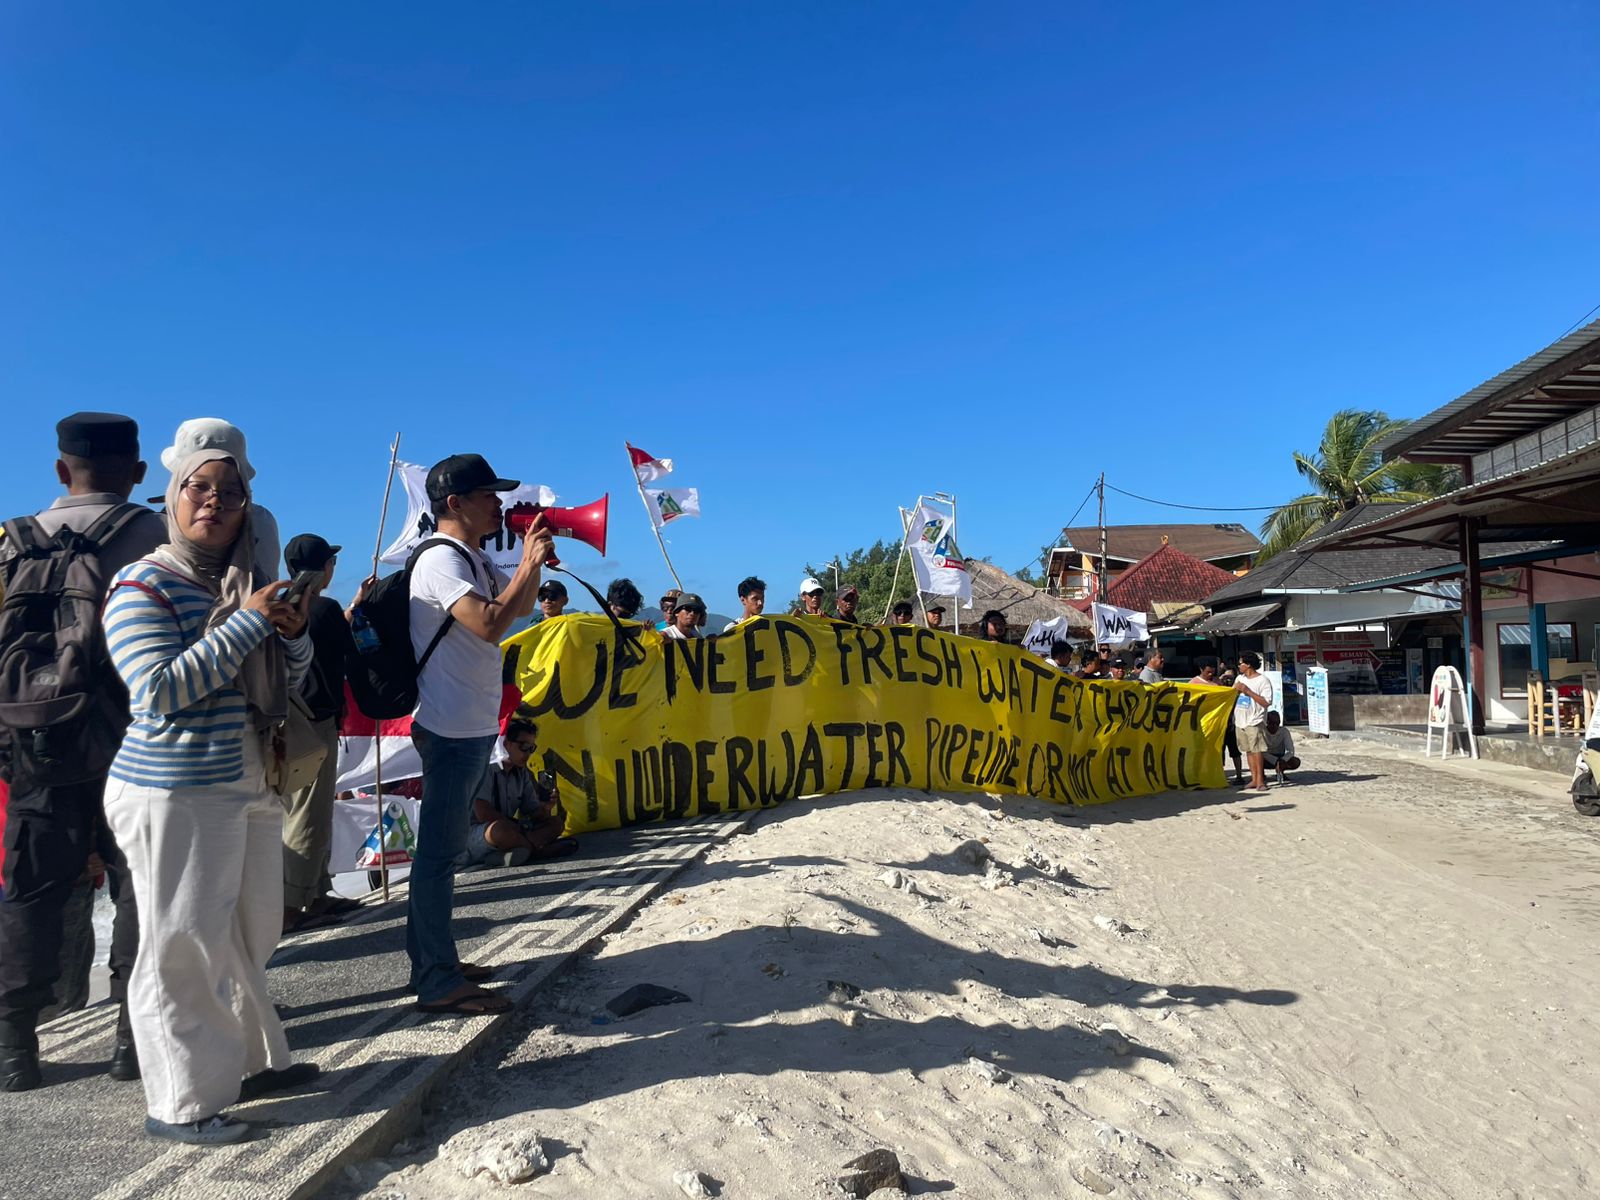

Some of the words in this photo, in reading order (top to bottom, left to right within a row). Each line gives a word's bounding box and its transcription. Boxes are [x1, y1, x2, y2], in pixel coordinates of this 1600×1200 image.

[502, 626, 641, 719] WE
[664, 618, 816, 705] NEED
[831, 622, 962, 689] FRESH
[970, 649, 1084, 731] WATER
[616, 720, 911, 827] UNDERWATER
[1027, 741, 1073, 804] OR
[1106, 746, 1134, 797] AT
[1143, 742, 1201, 790] ALL
